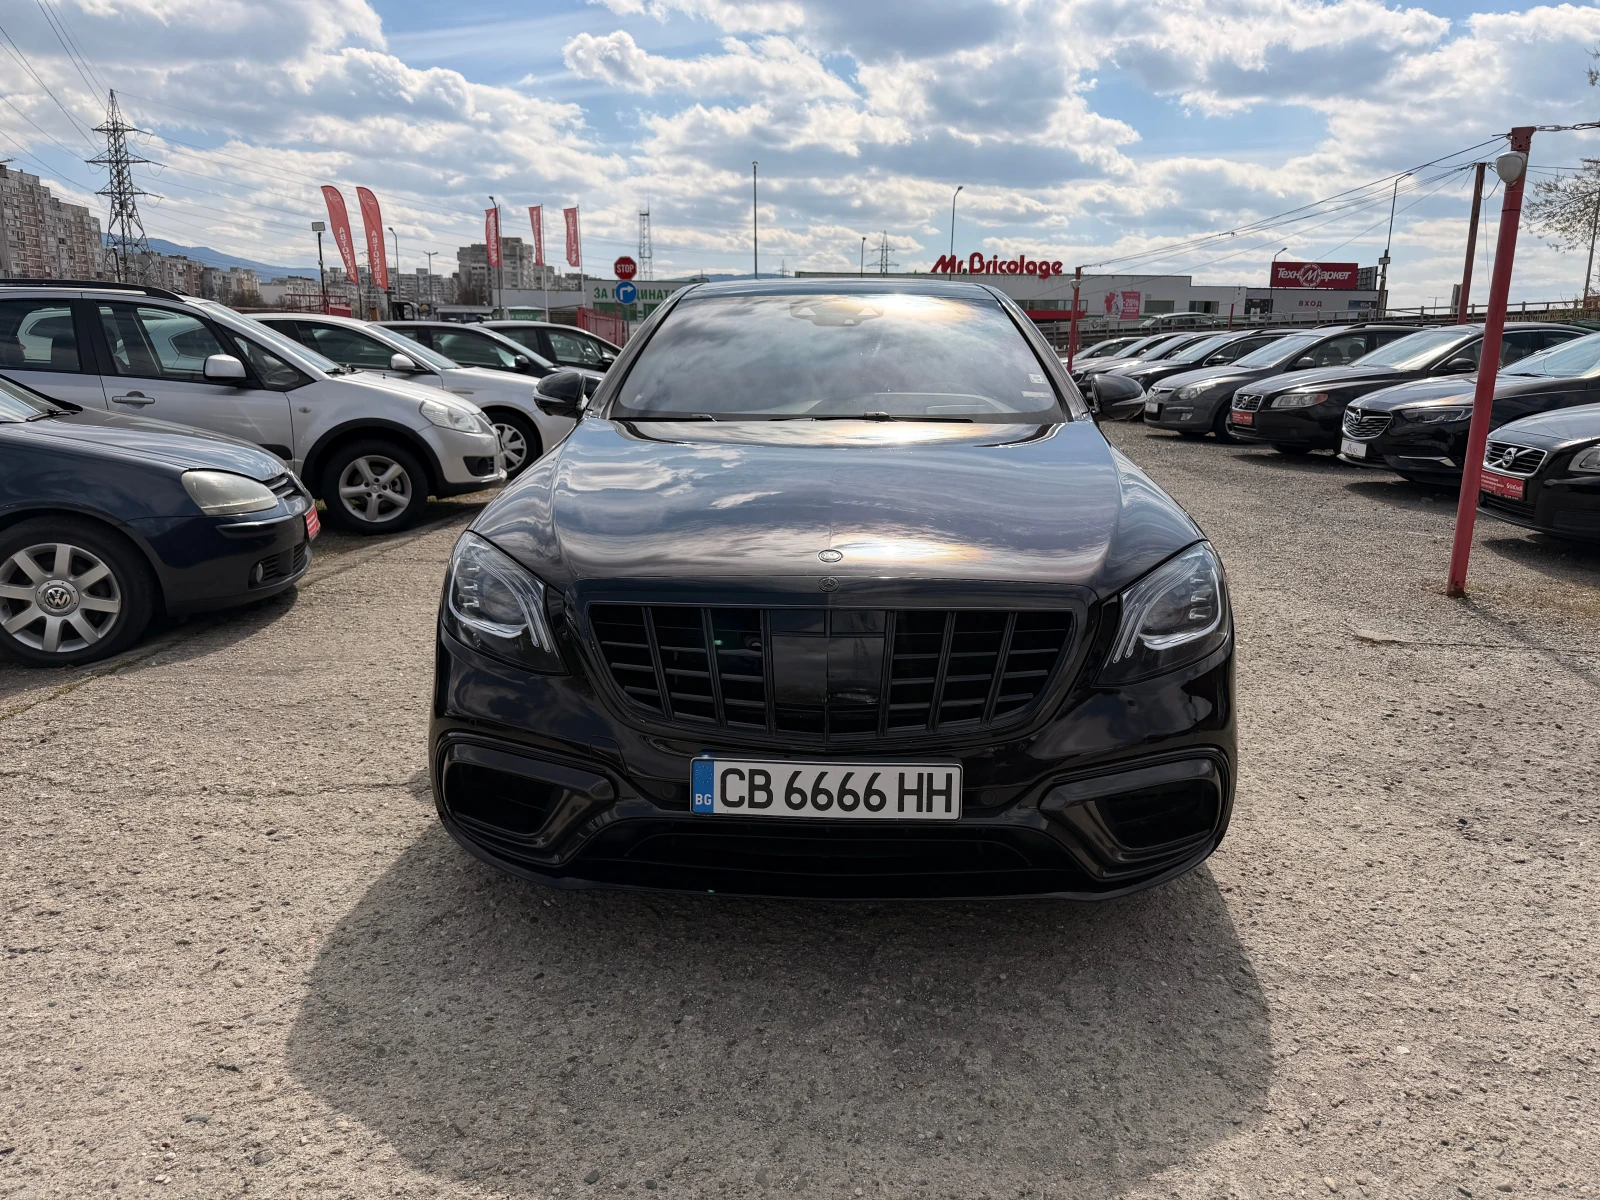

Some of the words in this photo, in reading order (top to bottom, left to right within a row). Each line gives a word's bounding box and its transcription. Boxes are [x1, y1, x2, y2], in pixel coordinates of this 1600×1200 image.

[616, 264, 634, 273] STOP
[594, 287, 608, 299] ЗА
[720, 768, 773, 809] CB
[784, 771, 887, 812] 6666
[897, 772, 953, 813] HH
[695, 794, 712, 806] BG
